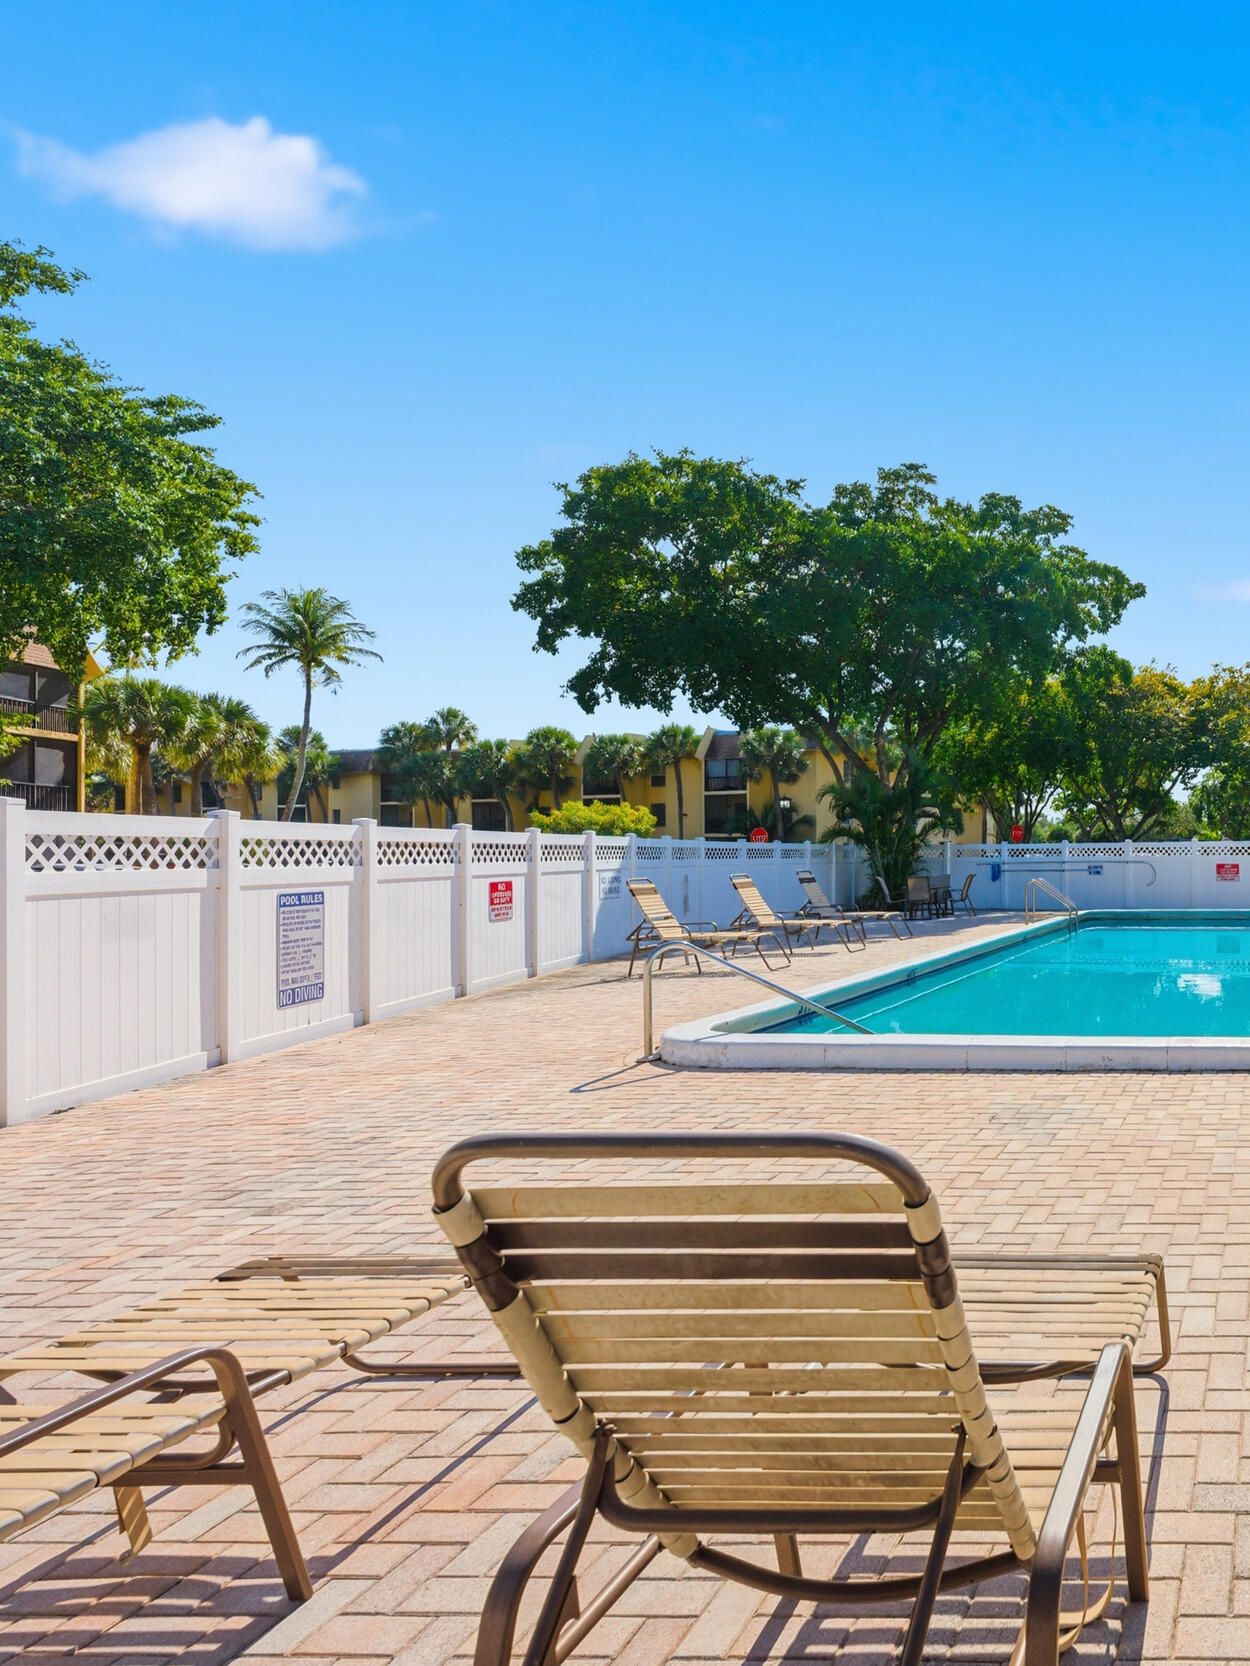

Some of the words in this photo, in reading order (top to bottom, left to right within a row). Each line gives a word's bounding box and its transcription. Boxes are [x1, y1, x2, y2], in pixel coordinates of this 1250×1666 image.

[280, 895, 300, 906] POOL
[301, 894, 323, 904] RULES
[280, 989, 293, 1006] NO
[294, 983, 323, 1003] DIVING
